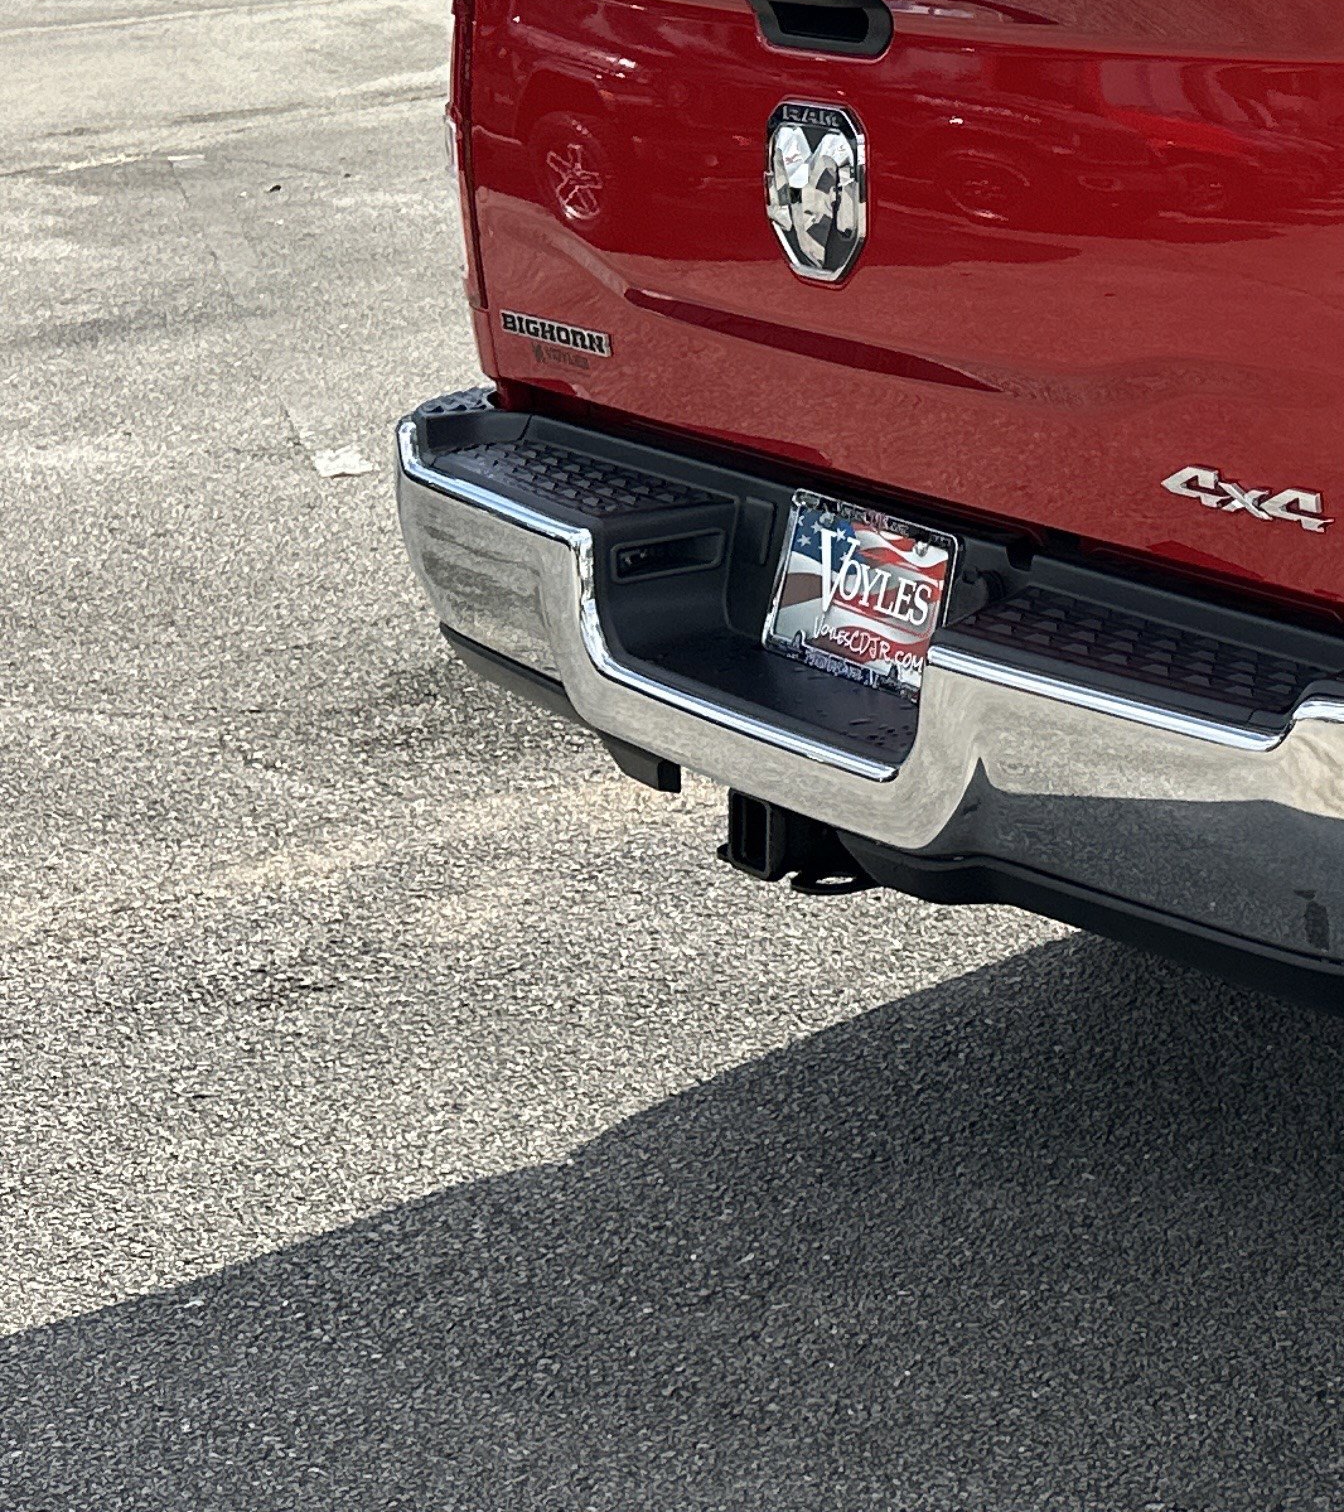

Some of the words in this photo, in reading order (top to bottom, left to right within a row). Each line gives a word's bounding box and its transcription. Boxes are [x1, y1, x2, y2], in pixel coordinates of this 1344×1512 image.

[782, 105, 840, 128] RAM
[501, 311, 606, 355] BIGHORN
[820, 527, 933, 627] VOYLES
